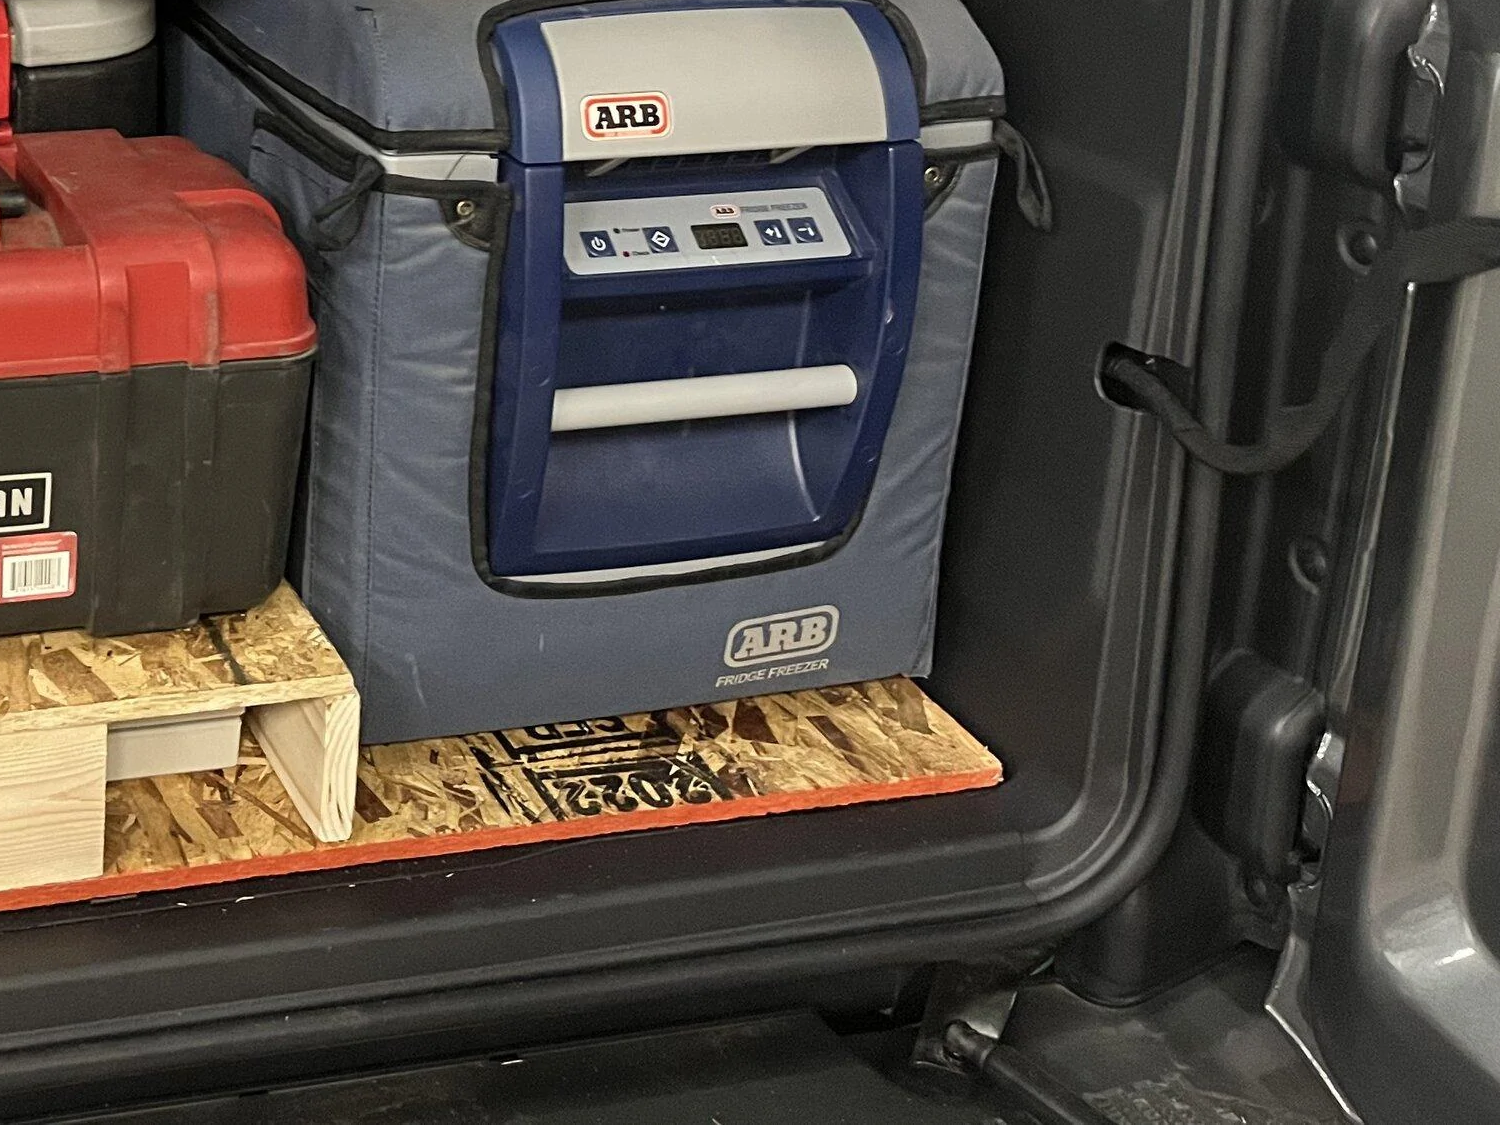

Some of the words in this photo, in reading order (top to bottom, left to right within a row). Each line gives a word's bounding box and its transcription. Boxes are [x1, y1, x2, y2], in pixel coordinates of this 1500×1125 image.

[595, 103, 660, 130] ARB
[733, 615, 828, 659] ARB
[715, 668, 768, 687] FRIDGE
[767, 658, 830, 679] FREEZER
